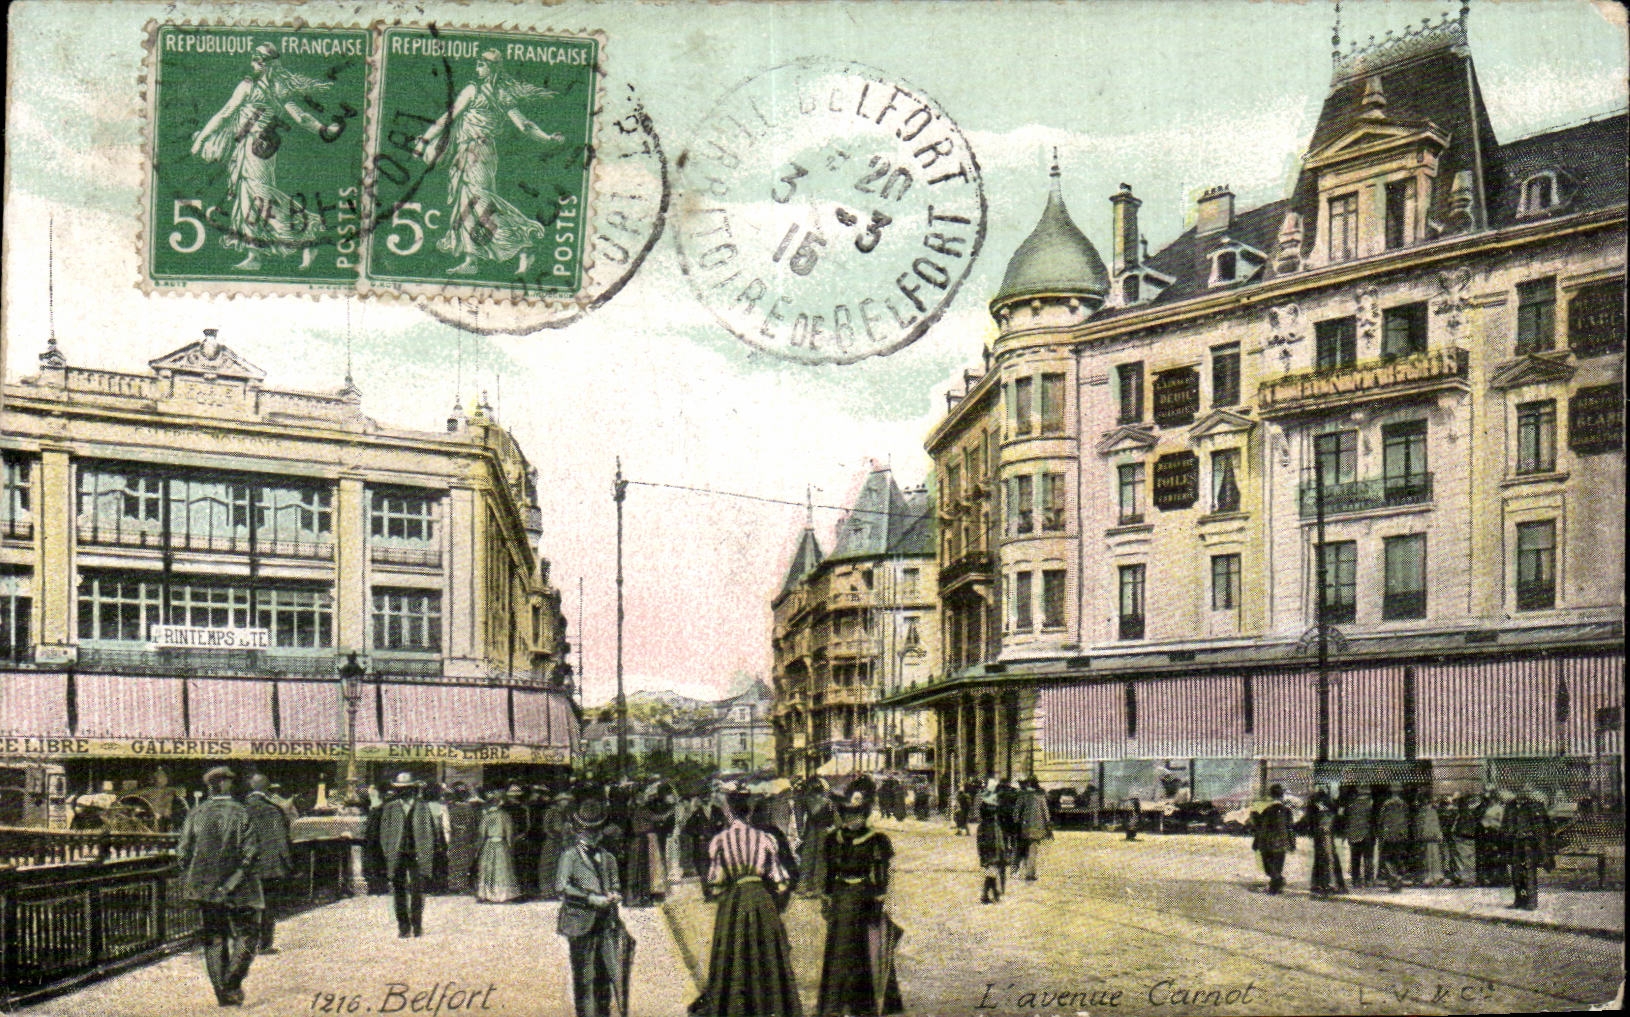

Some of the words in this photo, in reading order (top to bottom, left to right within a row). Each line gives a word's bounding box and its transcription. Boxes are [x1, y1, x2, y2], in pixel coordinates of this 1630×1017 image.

[281, 36, 363, 57] FRANÇAISE
[507, 43, 588, 66] FRANÇAISE
[336, 187, 359, 269] POSTES
[553, 195, 578, 276] POSTES
[832, 203, 972, 354] BELFORT
[24, 738, 89, 754] LIBRE
[131, 740, 233, 755] GALERIES
[250, 741, 352, 757] MODERNES
[462, 744, 510, 761] LIBRE
